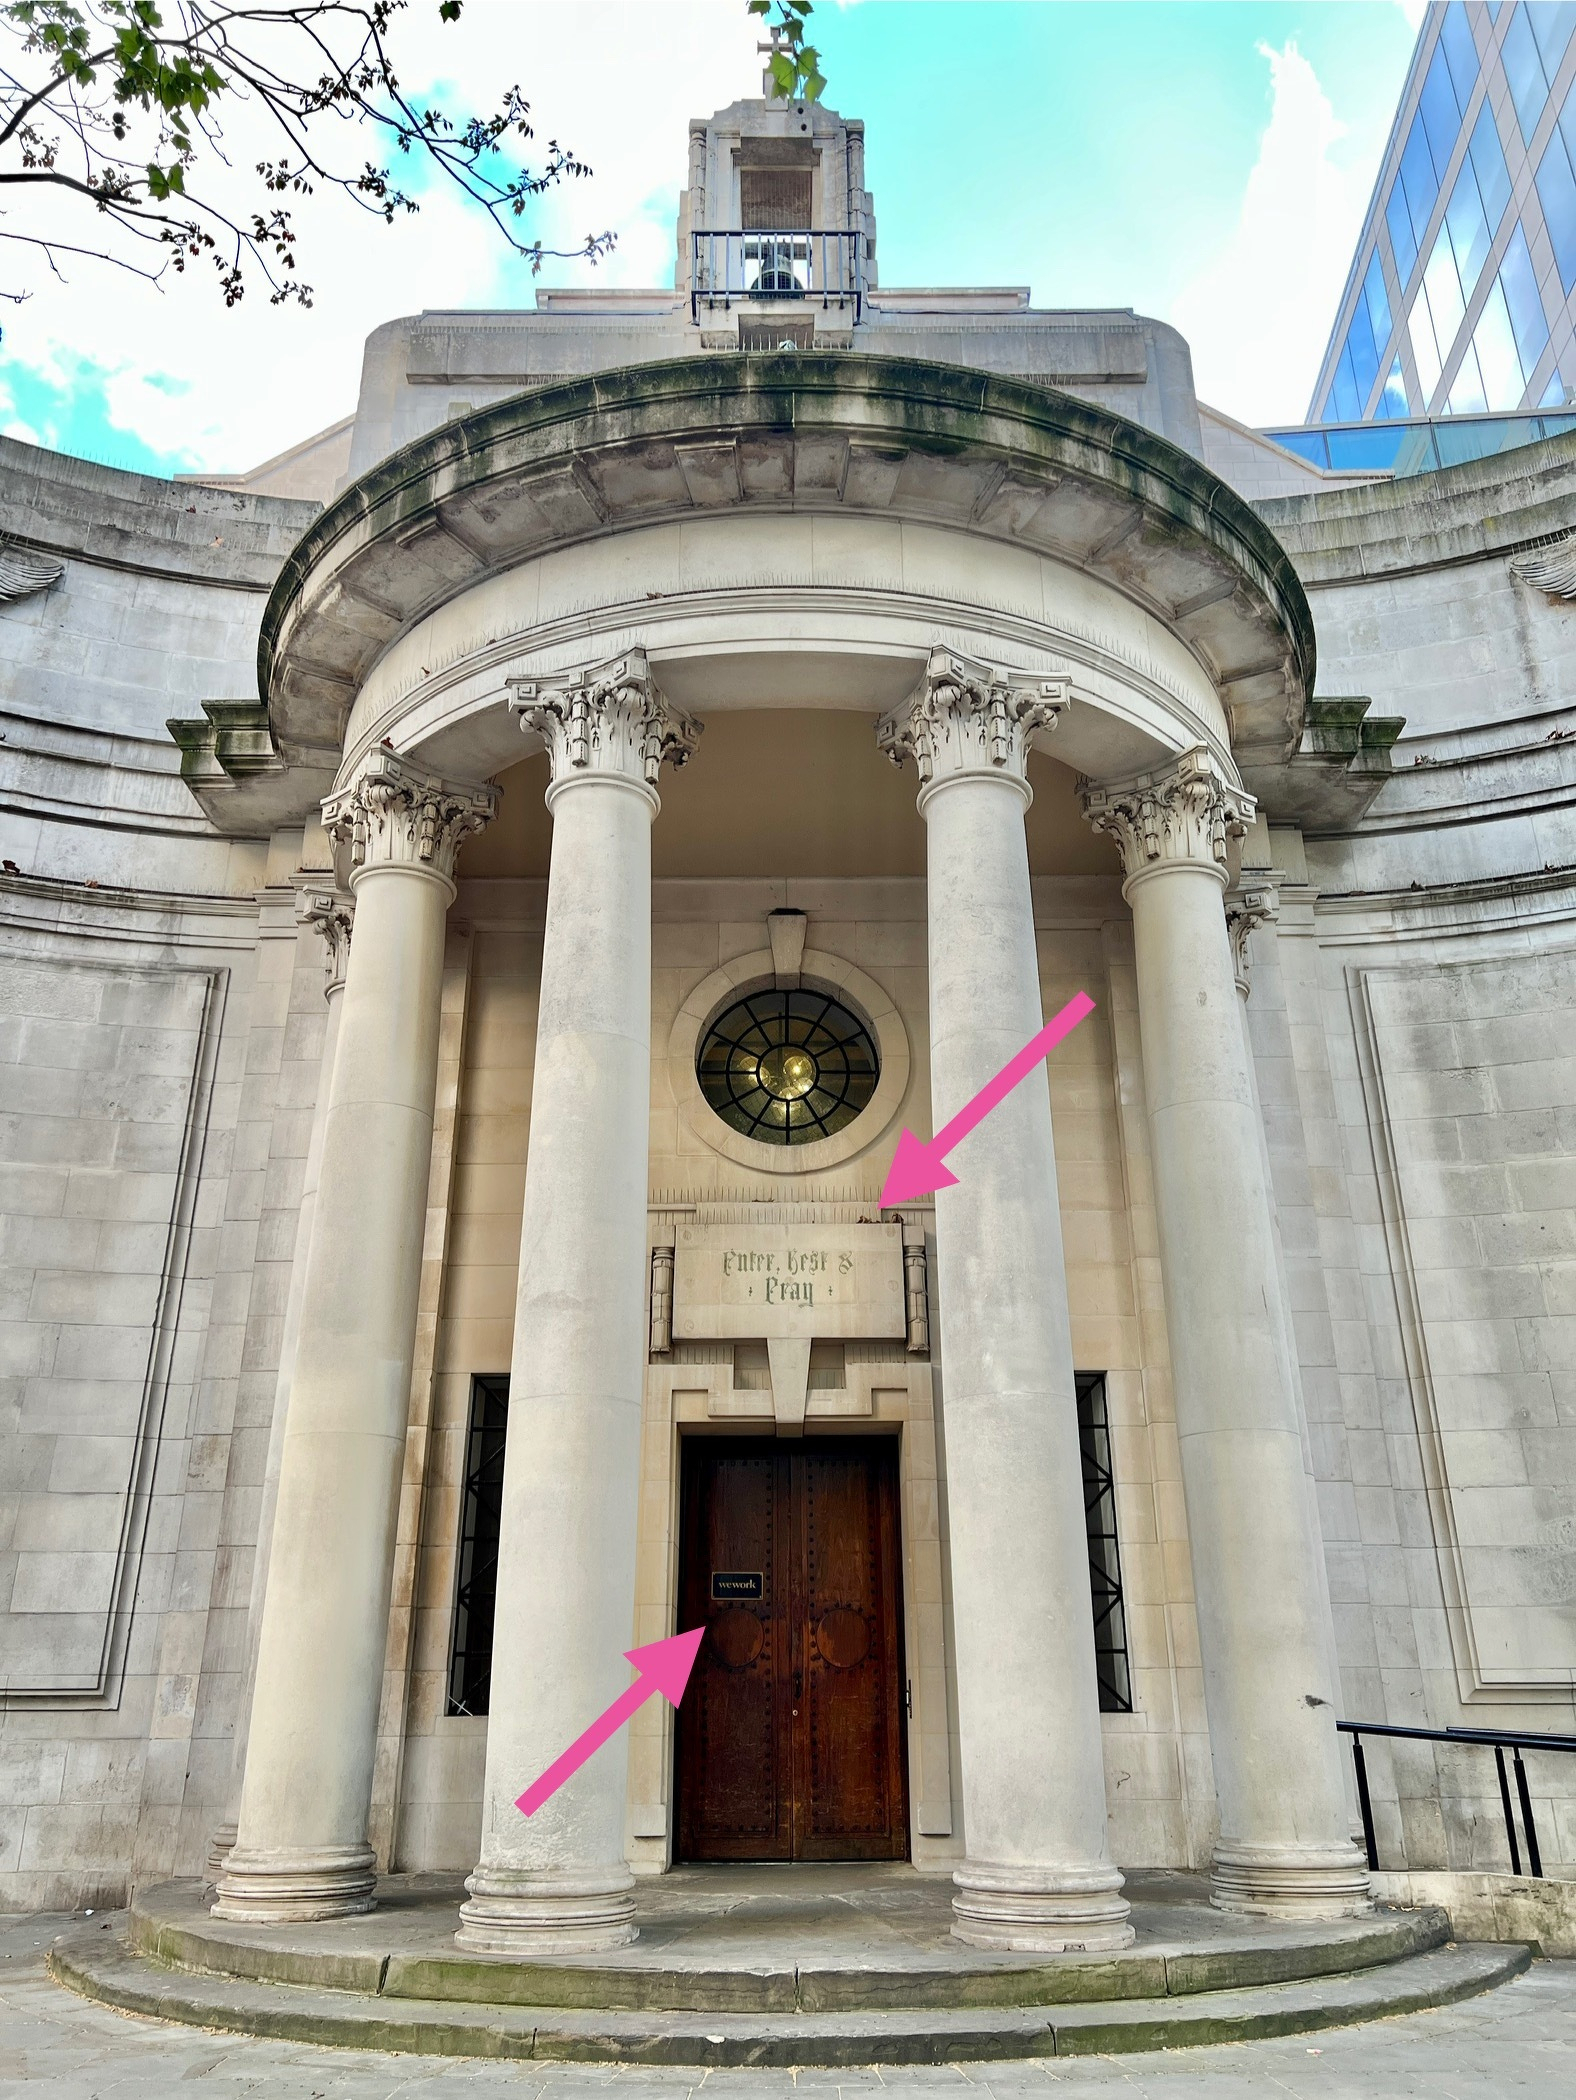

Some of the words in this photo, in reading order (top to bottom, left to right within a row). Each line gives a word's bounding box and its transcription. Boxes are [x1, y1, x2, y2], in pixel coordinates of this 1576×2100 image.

[723, 1248, 780, 1276] Enter,
[765, 1276, 814, 1308] Pray
[718, 1579, 756, 1589] wework
